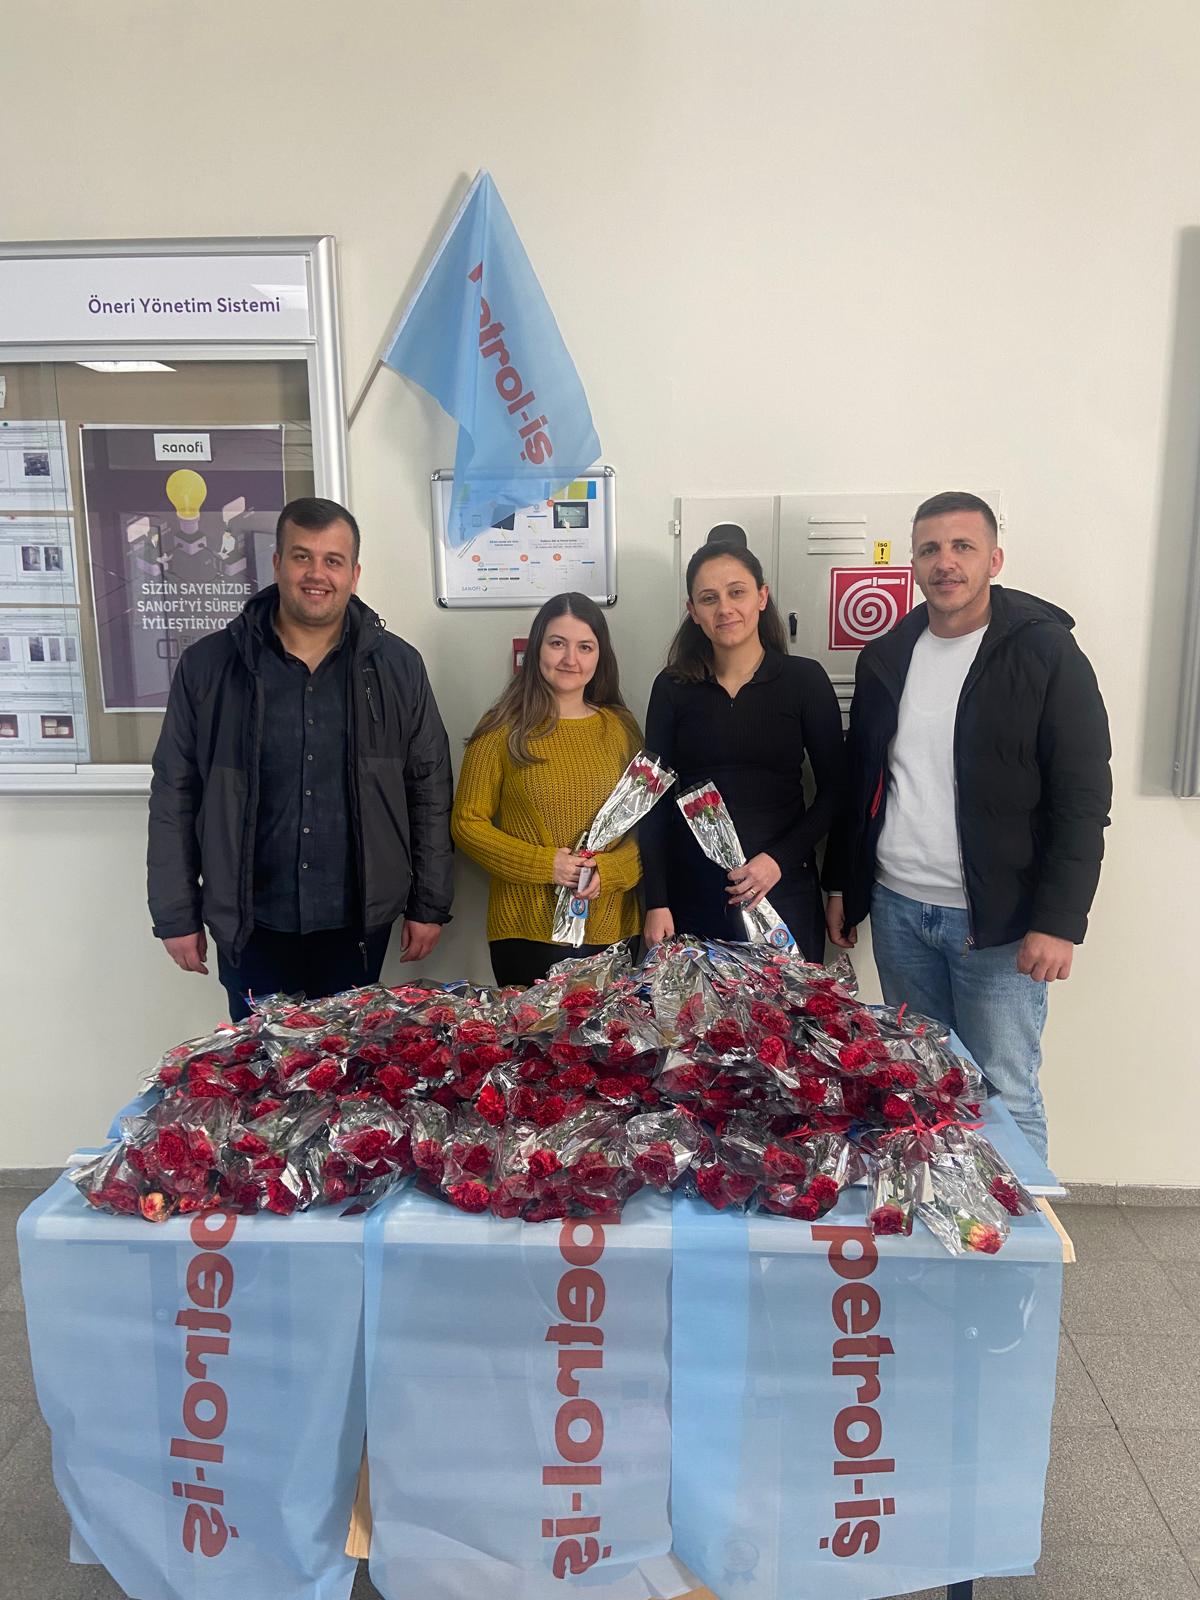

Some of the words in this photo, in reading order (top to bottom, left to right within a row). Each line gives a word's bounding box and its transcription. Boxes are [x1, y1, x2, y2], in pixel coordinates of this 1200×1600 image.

[88, 294, 135, 314] Öneri
[139, 297, 212, 313] Yönetim
[217, 296, 280, 313] Sistemi
[468, 260, 553, 465] trol-iş
[162, 441, 204, 453] sanofi
[141, 580, 178, 595] SİZİN
[180, 580, 252, 595] SAYENİZDE
[204, 598, 246, 612] SÜREK
[142, 615, 233, 631] İYİLEŞTİRİYO
[811, 1225, 896, 1558] petrol-iş
